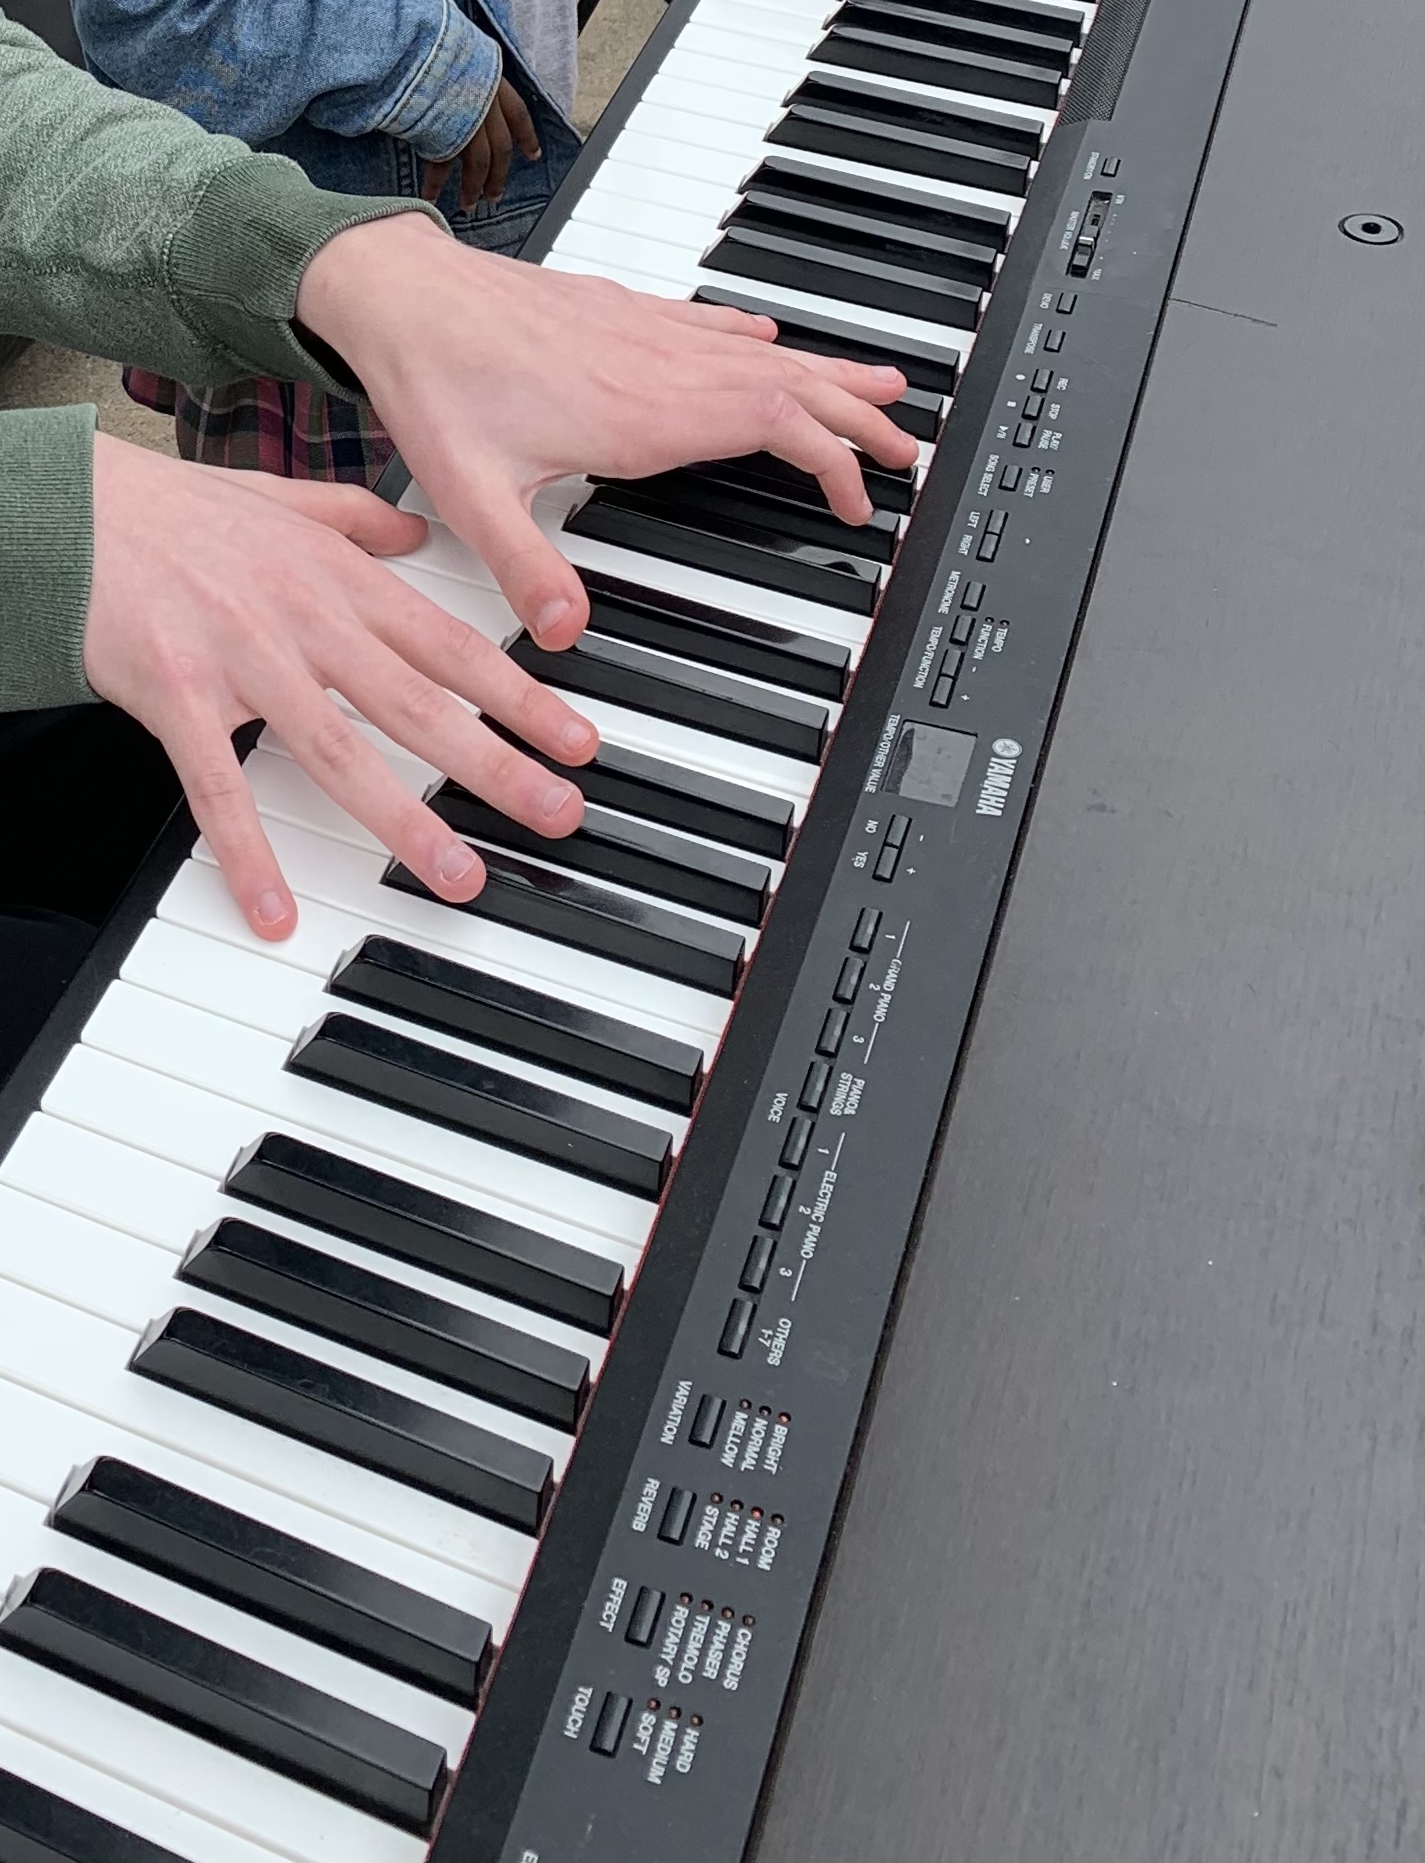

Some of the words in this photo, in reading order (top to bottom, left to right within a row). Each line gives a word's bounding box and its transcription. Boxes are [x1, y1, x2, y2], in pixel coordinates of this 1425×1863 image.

[1048, 403, 1061, 420] STOP
[985, 454, 1000, 472] SONG
[978, 473, 994, 497] SELECT
[1024, 473, 1040, 498] PRESET
[1039, 476, 1054, 494] USER
[967, 511, 981, 529] LEFT
[957, 534, 973, 556] RIGHT
[937, 570, 962, 615] METRONOME
[912, 626, 943, 689] TEMPO/FUNCTION
[973, 623, 993, 661] FUNCTION
[991, 627, 1008, 654] TEMPO
[873, 714, 901, 768] TEMPO/OTHER
[864, 768, 883, 794] VALUE
[975, 757, 1018, 817] YAMAHA
[865, 819, 879, 834] NO
[853, 851, 869, 869] YES
[883, 958, 902, 992] GRAND
[873, 992, 892, 1023] PIANO
[852, 1035, 865, 1045] 3
[767, 1092, 788, 1123] VOICE
[829, 1071, 854, 1117] STRINGS
[798, 1205, 812, 1216] 2
[811, 1170, 838, 1223] ELECTRIC
[800, 1223, 822, 1260] PIANO
[779, 1267, 793, 1278] 3
[767, 1318, 792, 1367] OTHERS
[660, 1380, 693, 1445] VARIATION
[720, 1411, 749, 1468] MELLOW
[740, 1417, 768, 1472] NORMAL
[763, 1424, 788, 1475] BRIGHT
[632, 1477, 661, 1532] REVERB
[694, 1505, 720, 1551] STAGE
[718, 1511, 740, 1546] HALL
[739, 1519, 761, 1553] HALL
[757, 1526, 782, 1571] ROOM
[714, 1547, 730, 1560] 2
[600, 1578, 628, 1633] EFFECT
[658, 1605, 690, 1665] ROTARY
[678, 1613, 711, 1684] TREMOLO
[701, 1620, 732, 1680] PHASER
[654, 1665, 669, 1688] SP
[723, 1628, 752, 1691] CHORUS
[563, 1686, 593, 1739] TOUCH
[632, 1712, 657, 1756] SOFT
[647, 1721, 678, 1785] MEDIUM
[675, 1728, 700, 1773] HARD
